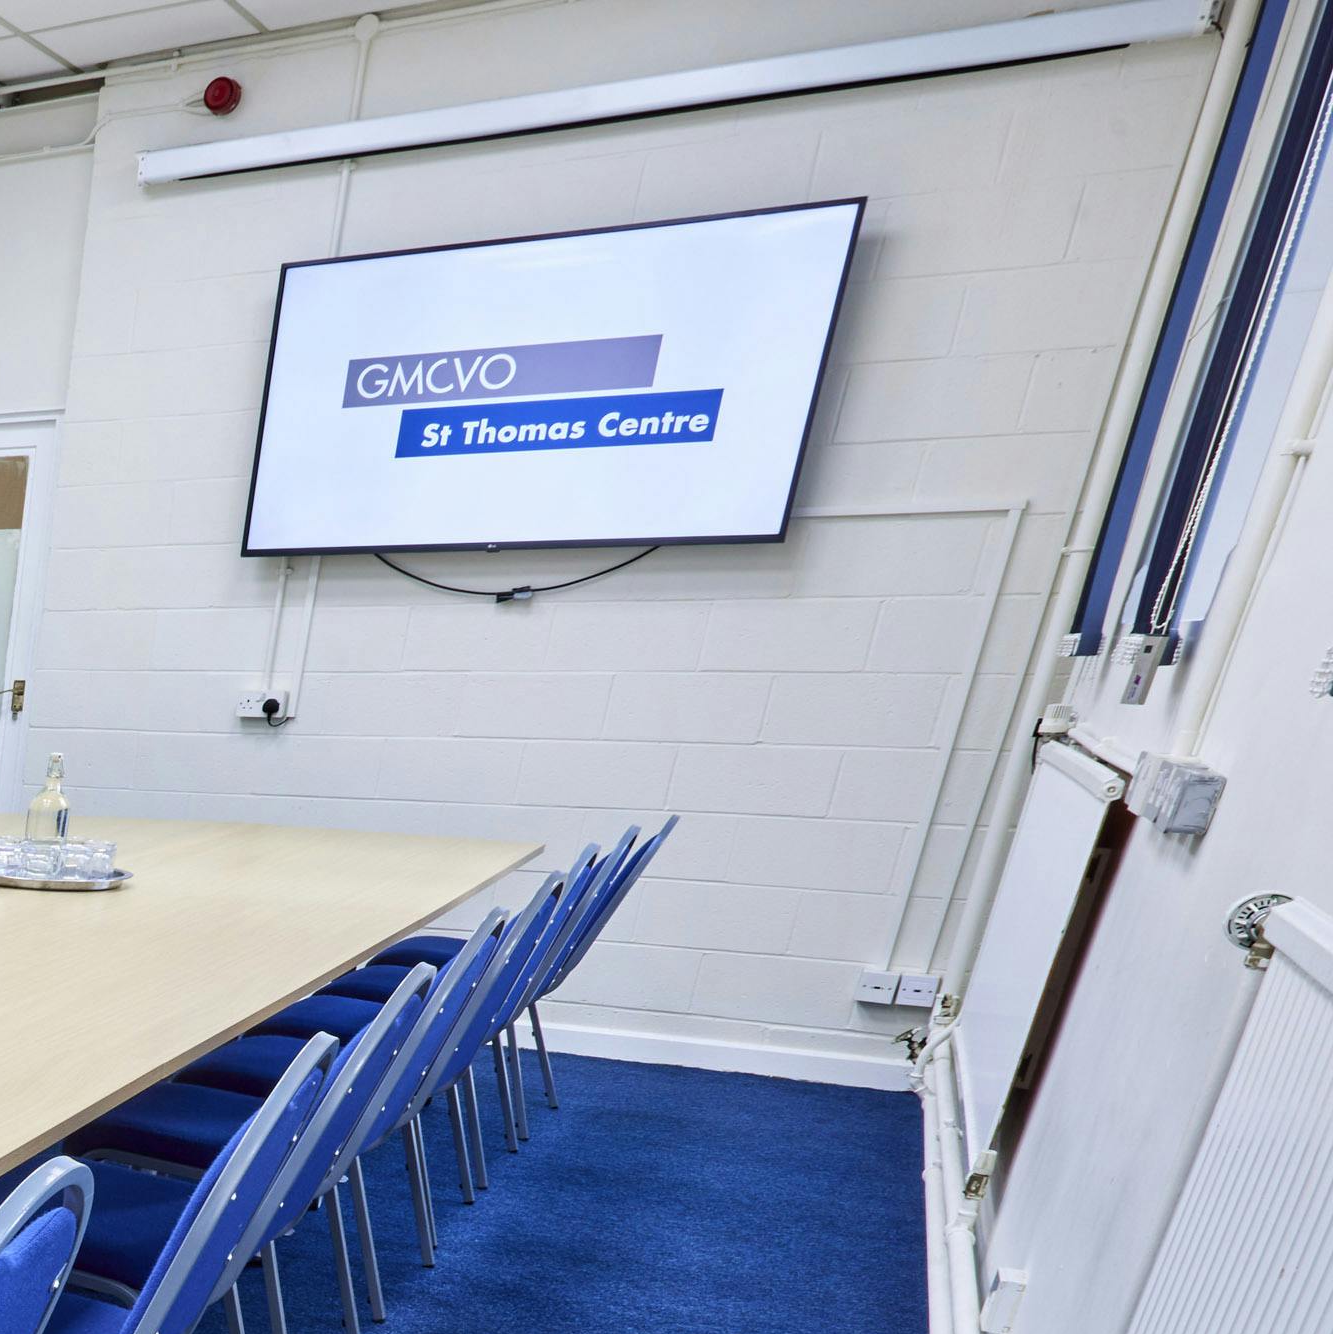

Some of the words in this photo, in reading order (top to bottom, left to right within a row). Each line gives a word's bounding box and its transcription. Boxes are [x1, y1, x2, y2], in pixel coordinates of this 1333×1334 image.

[356, 352, 517, 399] GMCVO
[420, 422, 452, 448] St
[462, 415, 586, 446] Thomas
[598, 409, 710, 440] Centre
